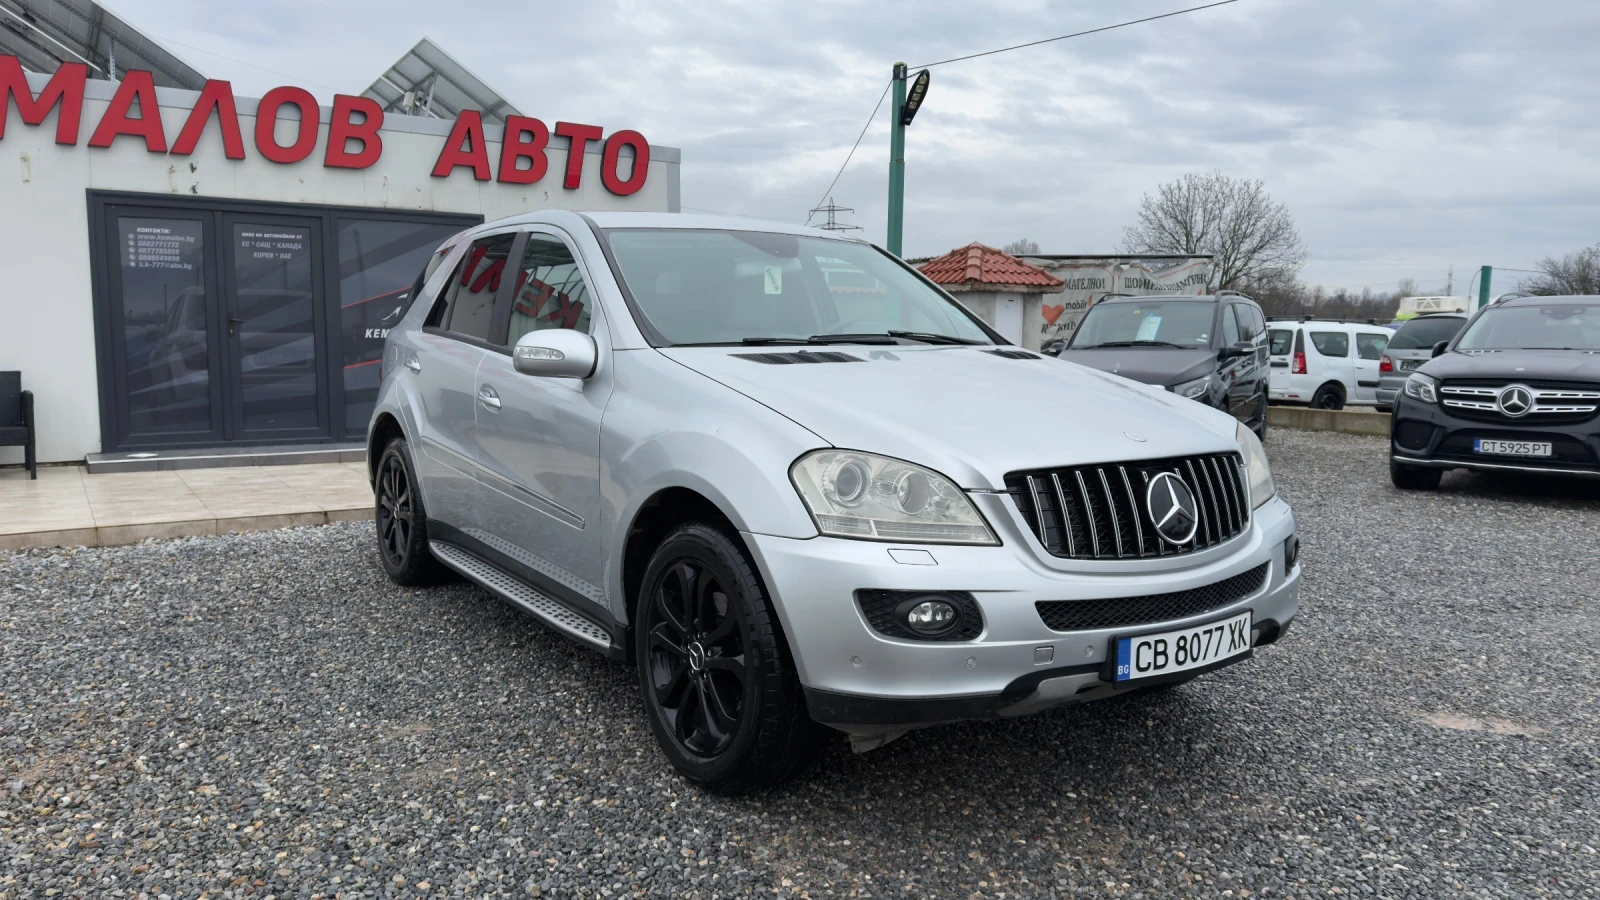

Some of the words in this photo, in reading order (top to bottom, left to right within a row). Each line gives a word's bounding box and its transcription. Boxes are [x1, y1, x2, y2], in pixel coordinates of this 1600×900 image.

[430, 108, 650, 196] АВТО
[137, 234, 195, 243] www.kemalov.bg
[137, 240, 180, 248] 0882771772
[277, 242, 302, 250] КАНАДА
[1064, 277, 1106, 290] МАТЕЛНО!
[1481, 441, 1498, 452] CT
[1499, 442, 1530, 454] 5925
[1532, 443, 1550, 455] PT
[1135, 638, 1169, 673] CB
[1174, 625, 1225, 666] 8077
[1227, 617, 1248, 653] XK
[1117, 664, 1130, 676] BG
